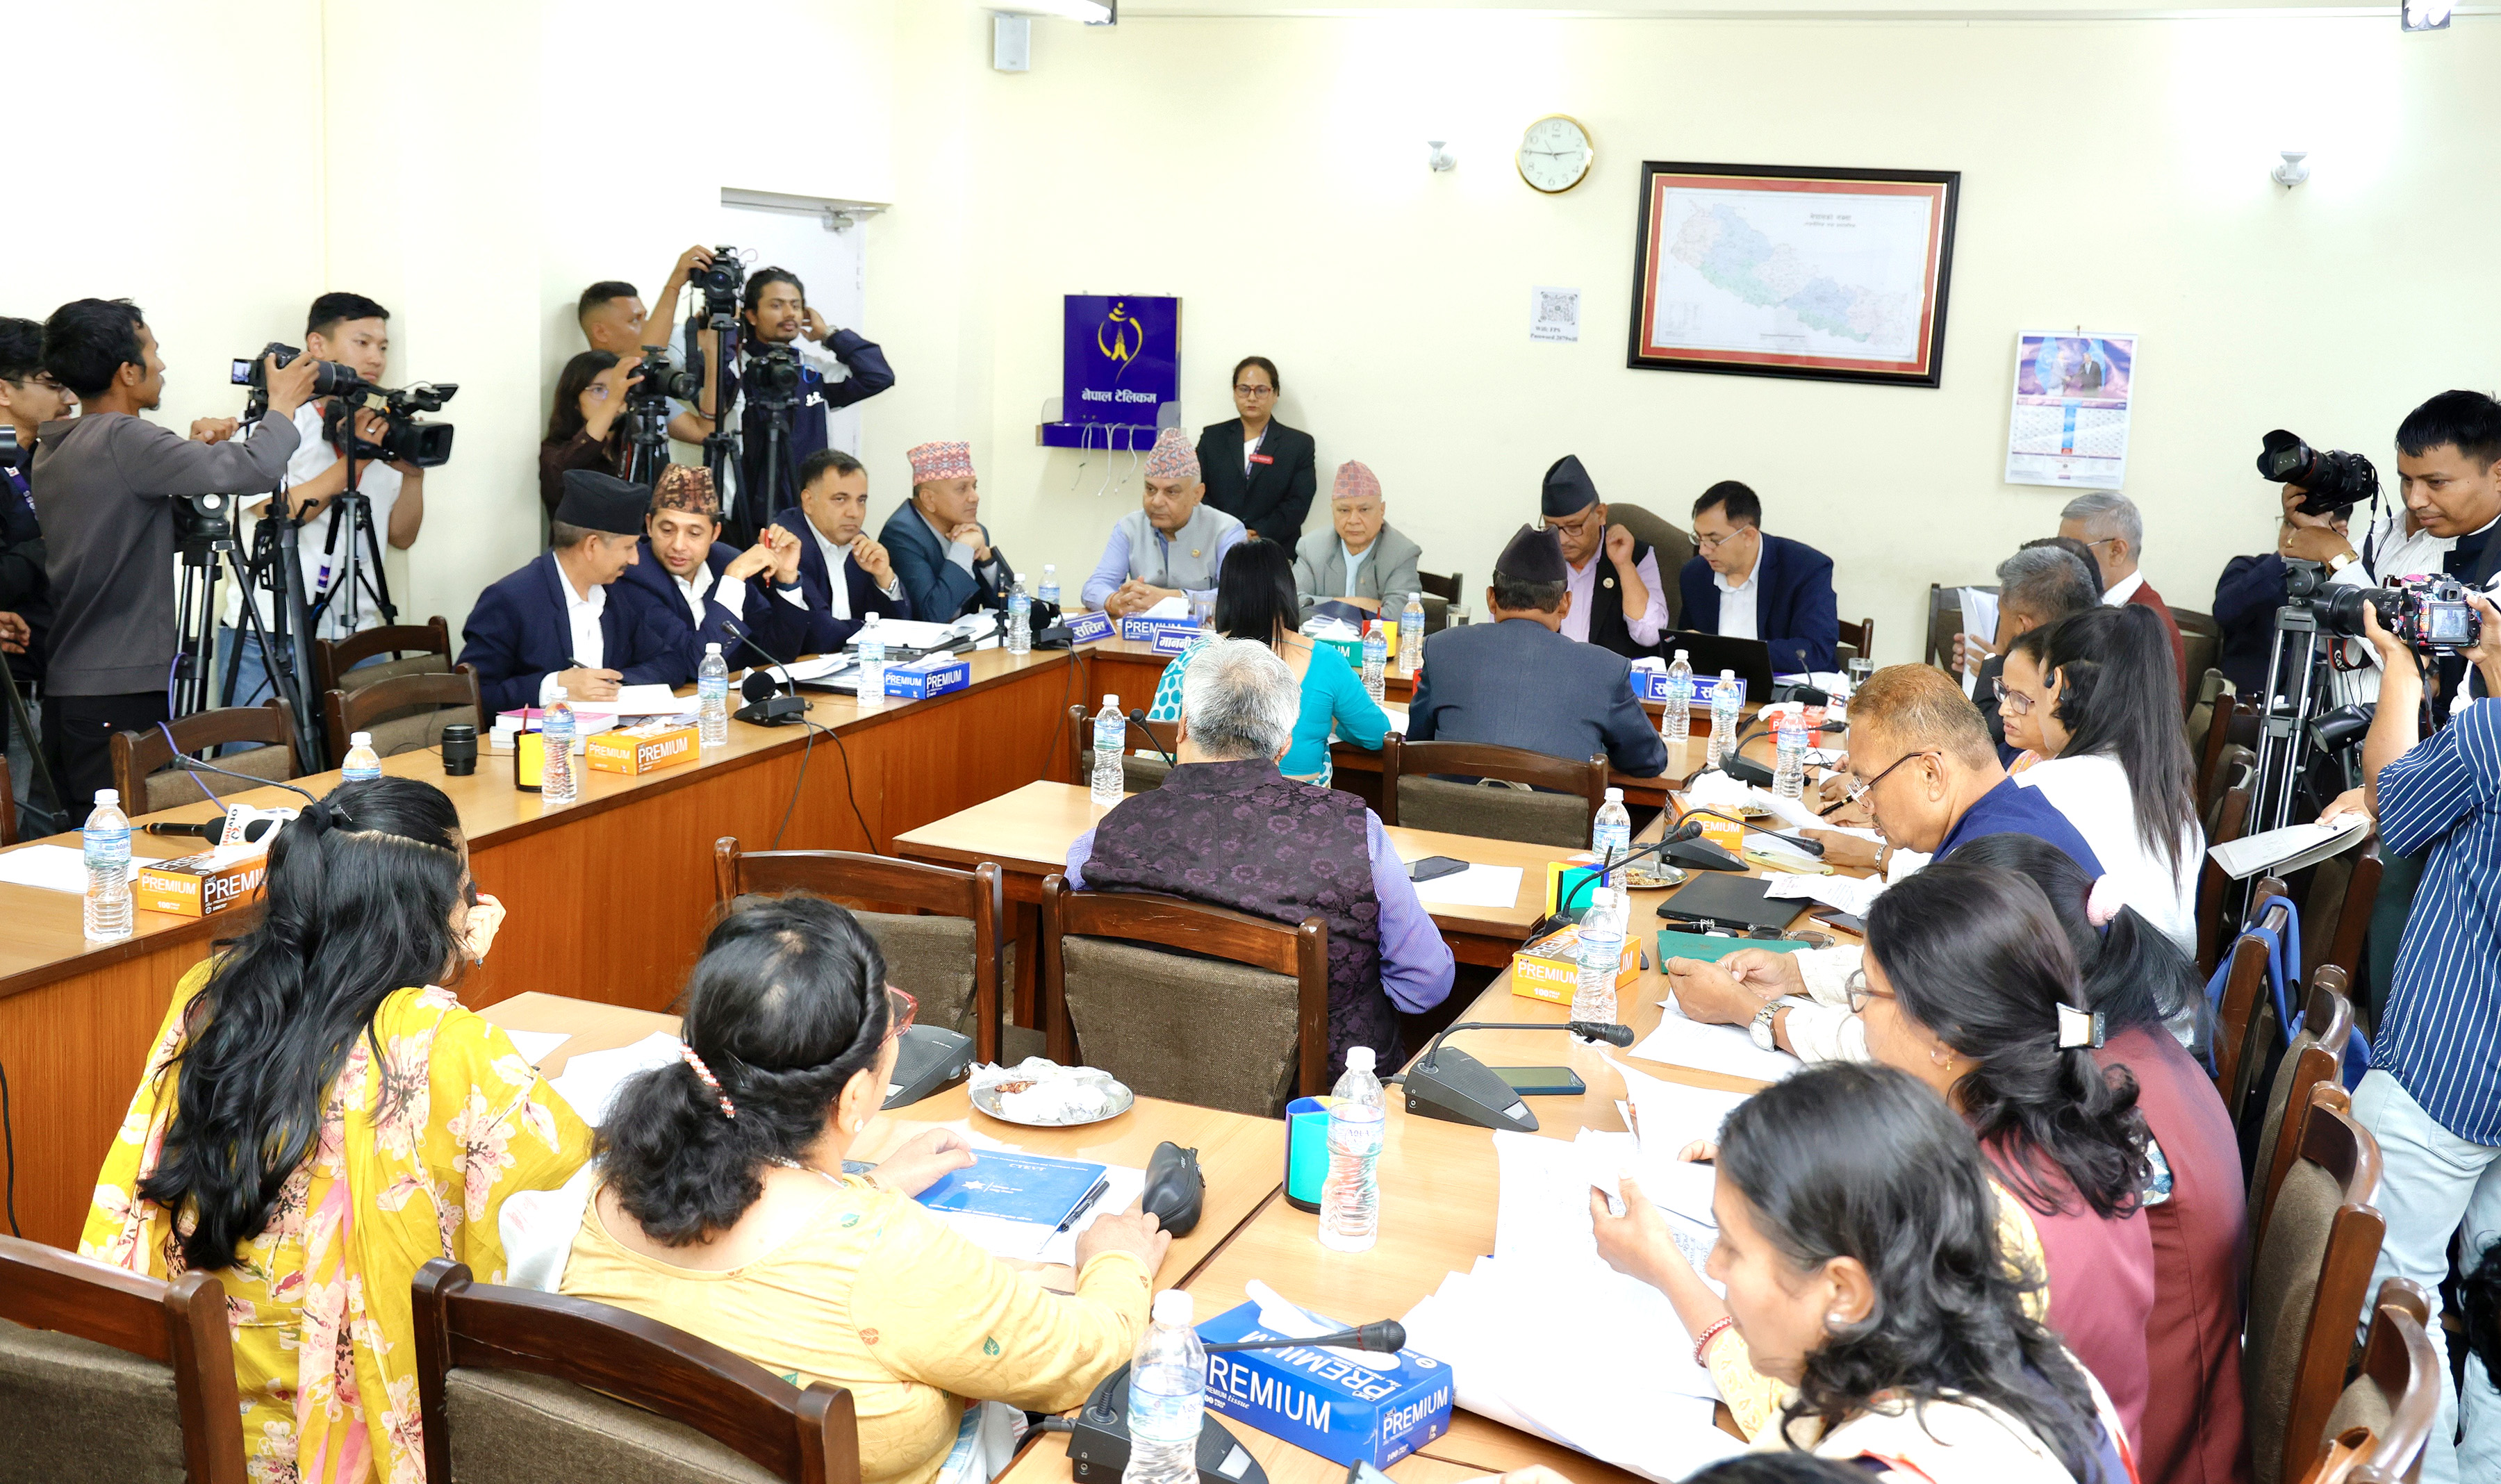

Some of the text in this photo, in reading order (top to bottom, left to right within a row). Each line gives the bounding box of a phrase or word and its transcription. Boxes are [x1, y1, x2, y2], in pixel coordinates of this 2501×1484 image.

[1548, 177, 1555, 186] 6
[1082, 388, 1157, 404] नेपाल टेलिकम
[885, 674, 923, 686] PREMIUM
[926, 669, 962, 690] PREMIUM
[588, 744, 631, 760] PREMIUM
[638, 736, 688, 764] PREMIUM
[142, 876, 196, 895] PREMIUM
[157, 900, 170, 909] 100
[1534, 987, 1549, 997] 100
[1203, 1352, 1332, 1435] REMIUM
[1204, 1394, 1214, 1404] 00
[1228, 1394, 1250, 1410] tissue
[1382, 1385, 1448, 1440] PREMIUM
